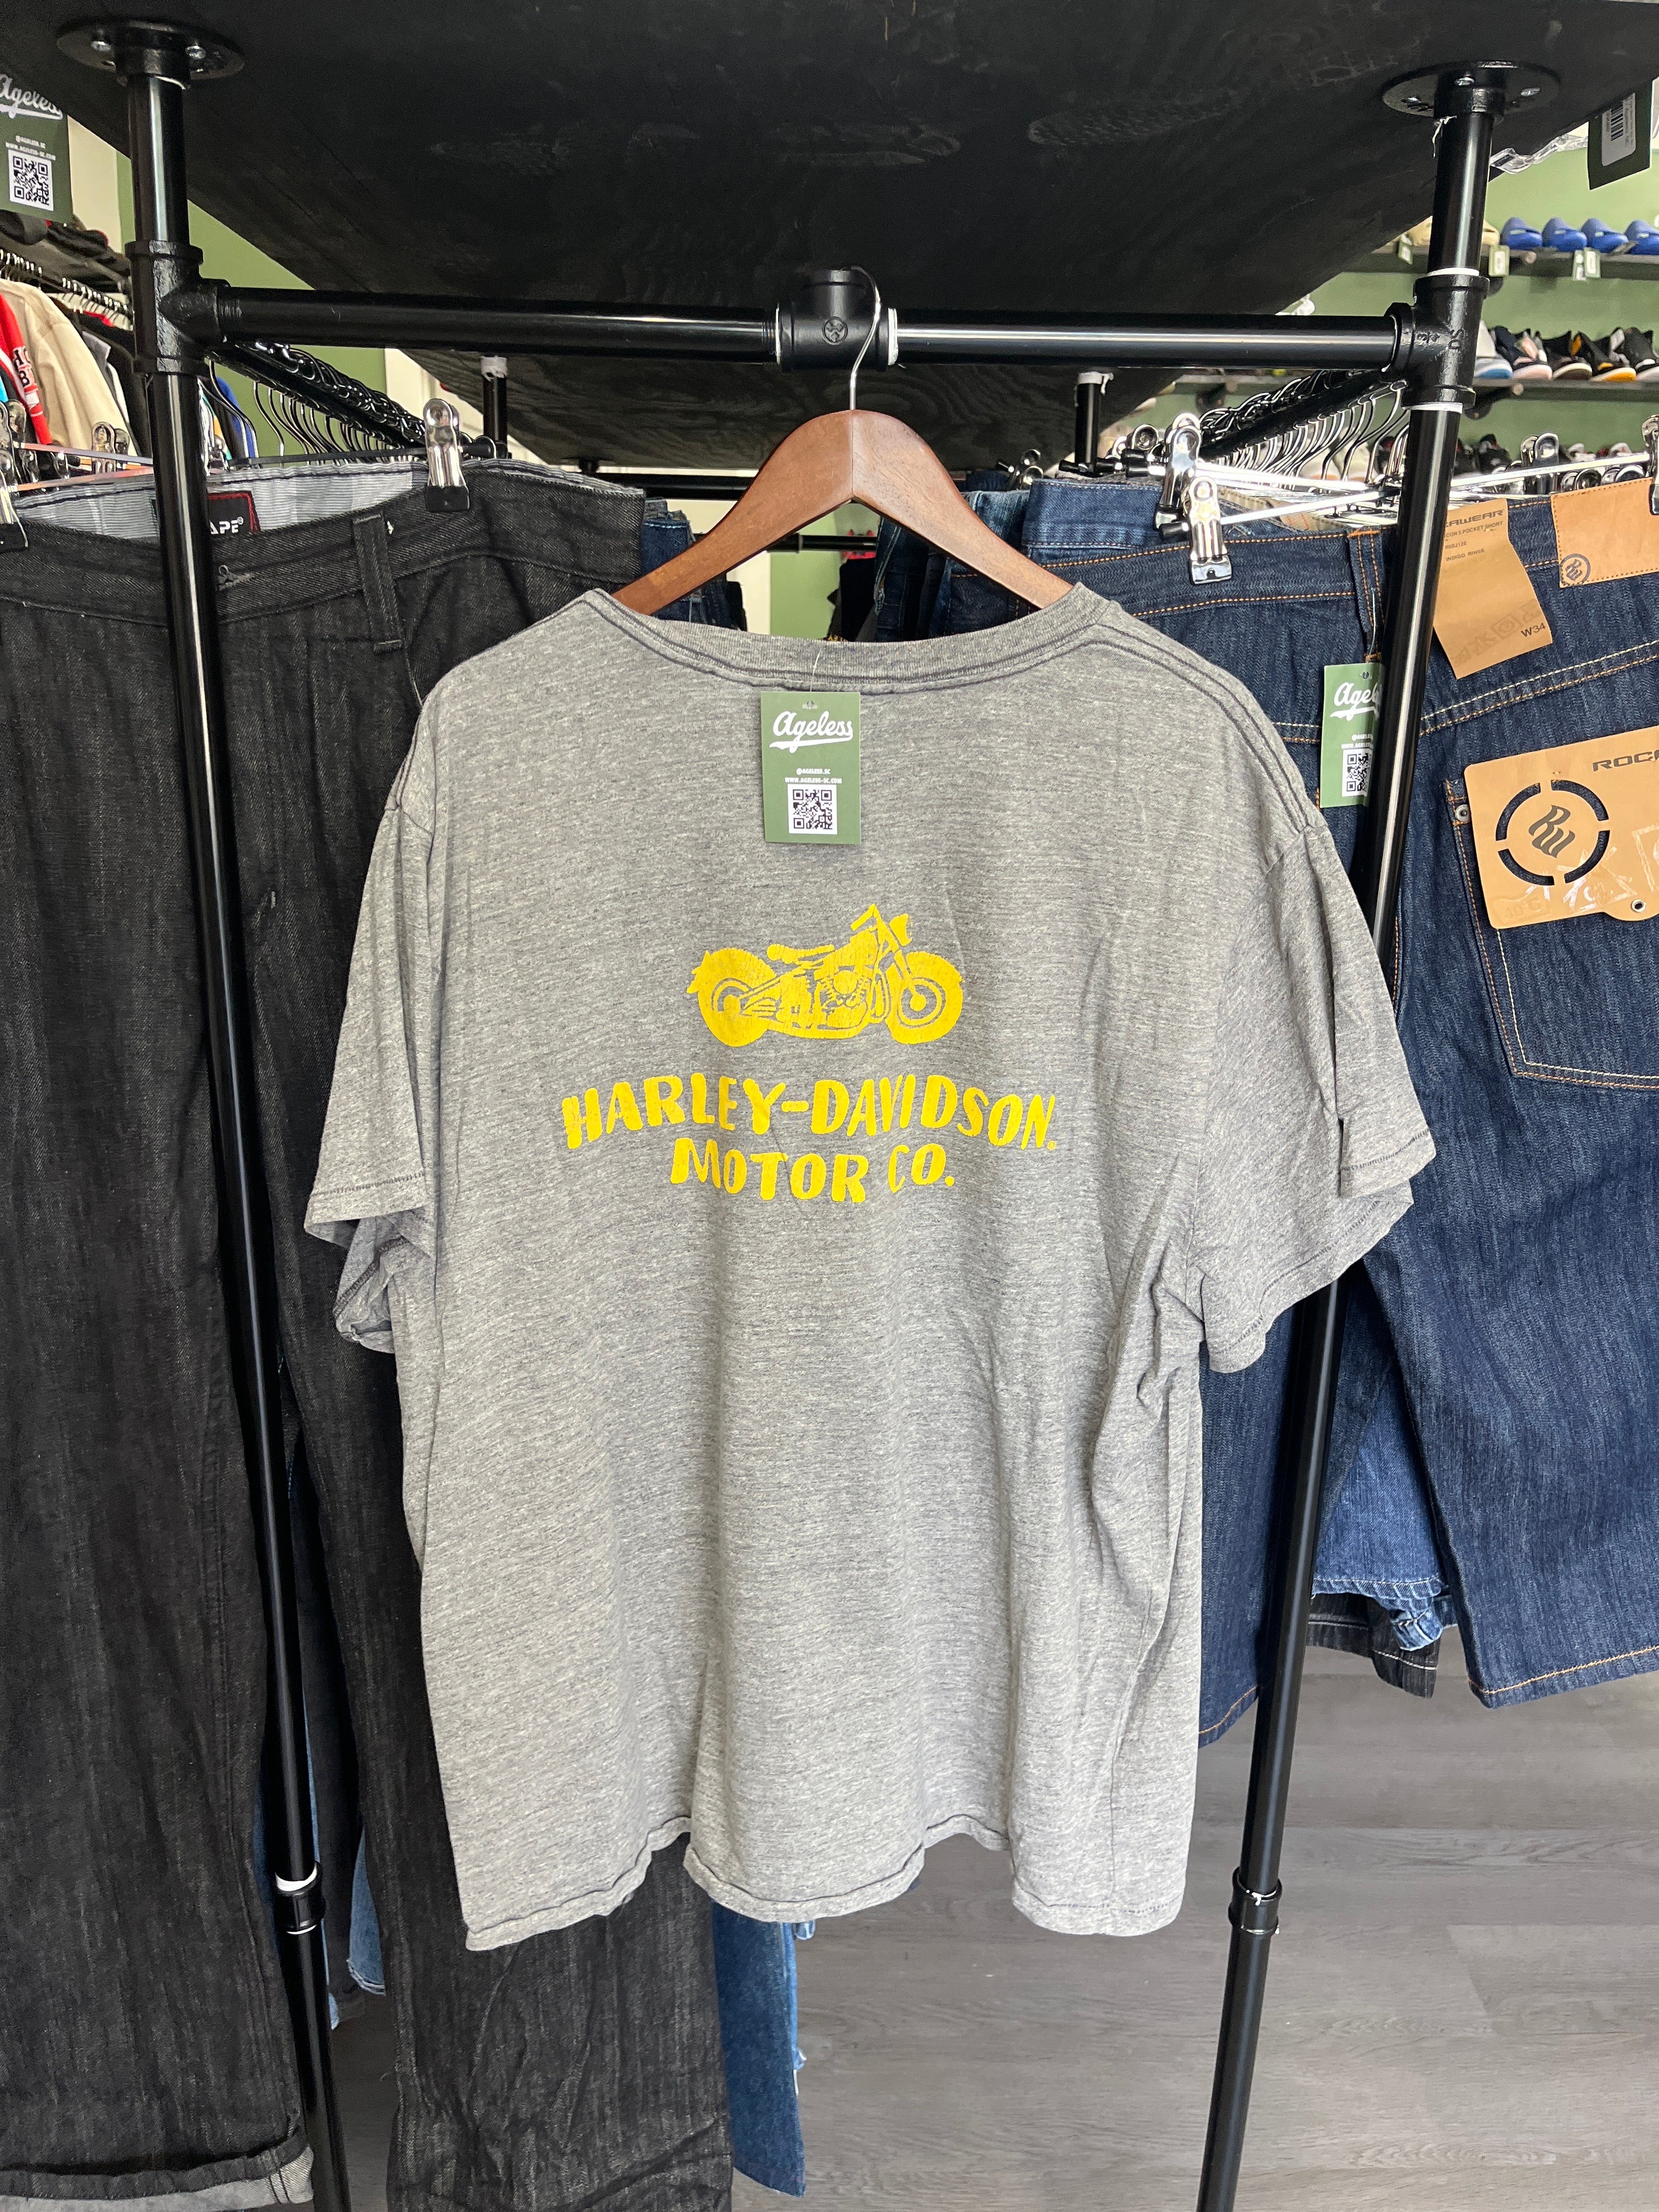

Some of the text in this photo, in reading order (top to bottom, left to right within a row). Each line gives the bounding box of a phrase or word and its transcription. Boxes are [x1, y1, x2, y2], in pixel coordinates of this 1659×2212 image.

[1445, 510, 1504, 527] AWEAR
[1463, 525, 1483, 534] POCKET
[1485, 521, 1503, 530] SHORT
[1446, 549, 1486, 561] INDIGO RINSE
[1521, 623, 1545, 637] W34
[1330, 682, 1378, 721] Agel
[769, 711, 853, 753] Ageless
[670, 1137, 955, 1203] MOTOR CO.
